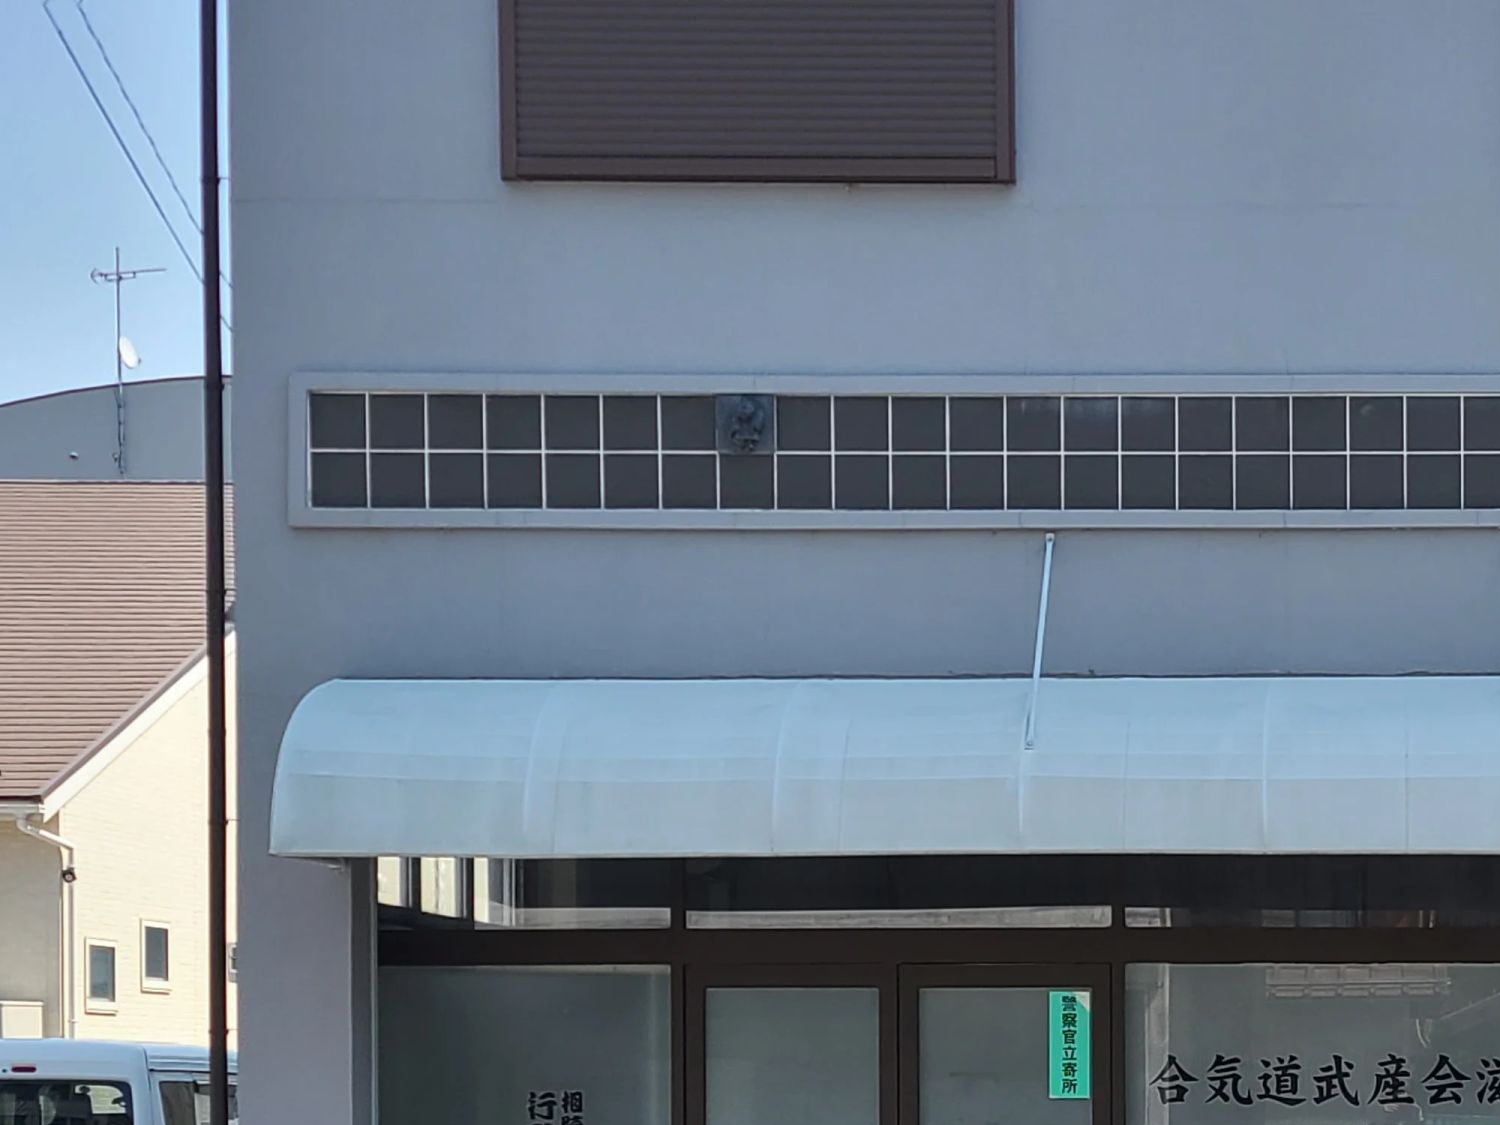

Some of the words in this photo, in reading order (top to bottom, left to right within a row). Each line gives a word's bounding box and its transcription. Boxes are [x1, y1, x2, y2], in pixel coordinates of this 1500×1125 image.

[1062, 995, 1078, 1094] 警察官立寄所
